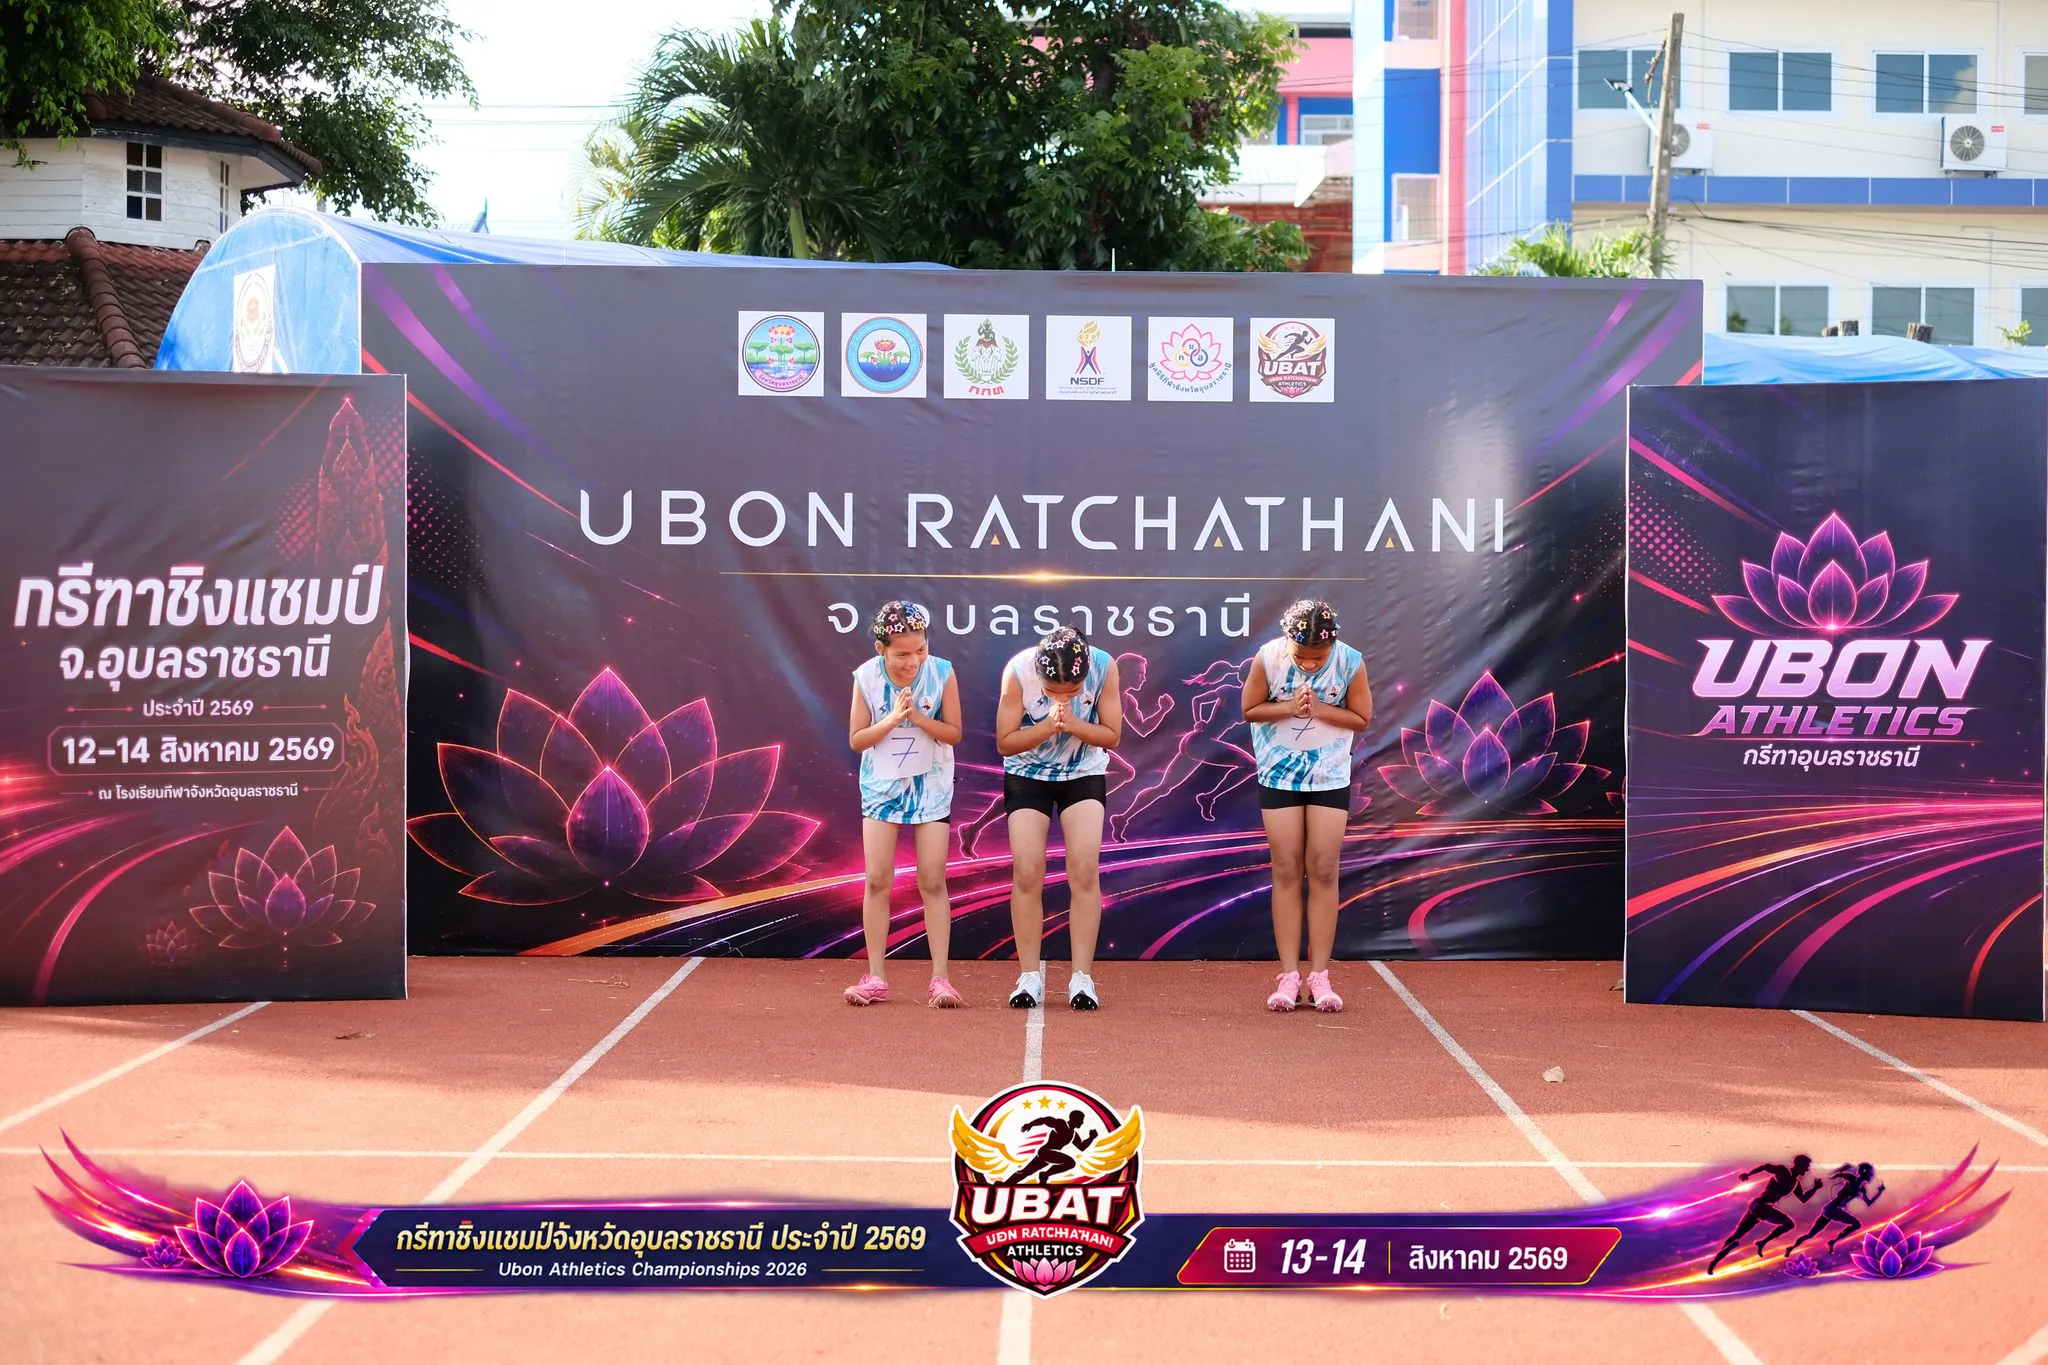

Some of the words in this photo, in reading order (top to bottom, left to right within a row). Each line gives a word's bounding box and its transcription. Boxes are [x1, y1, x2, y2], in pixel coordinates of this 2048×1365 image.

[1070, 377, 1105, 386] NSDF
[1264, 361, 1321, 376] UBAT
[580, 489, 853, 547] UBON
[908, 493, 1503, 552] RATCHATHANI
[14, 562, 384, 627] กรีฑาชิงแชมป์
[60, 634, 331, 691] จ.อุบลราชธานี
[1692, 639, 1993, 699] UBON
[143, 698, 204, 717] ประจำปี
[210, 700, 254, 716] 2569
[1702, 705, 1972, 736] ATHLETICS
[160, 737, 259, 763] สิงหาคม
[268, 737, 334, 762] 2569
[892, 737, 919, 768] 7
[1742, 744, 1921, 772] กรีฑาอุบลราชธานี
[98, 788, 110, 801] ณ
[116, 782, 298, 801] โรงเรียนกีฬาจังหวัดอุบลราชธานี
